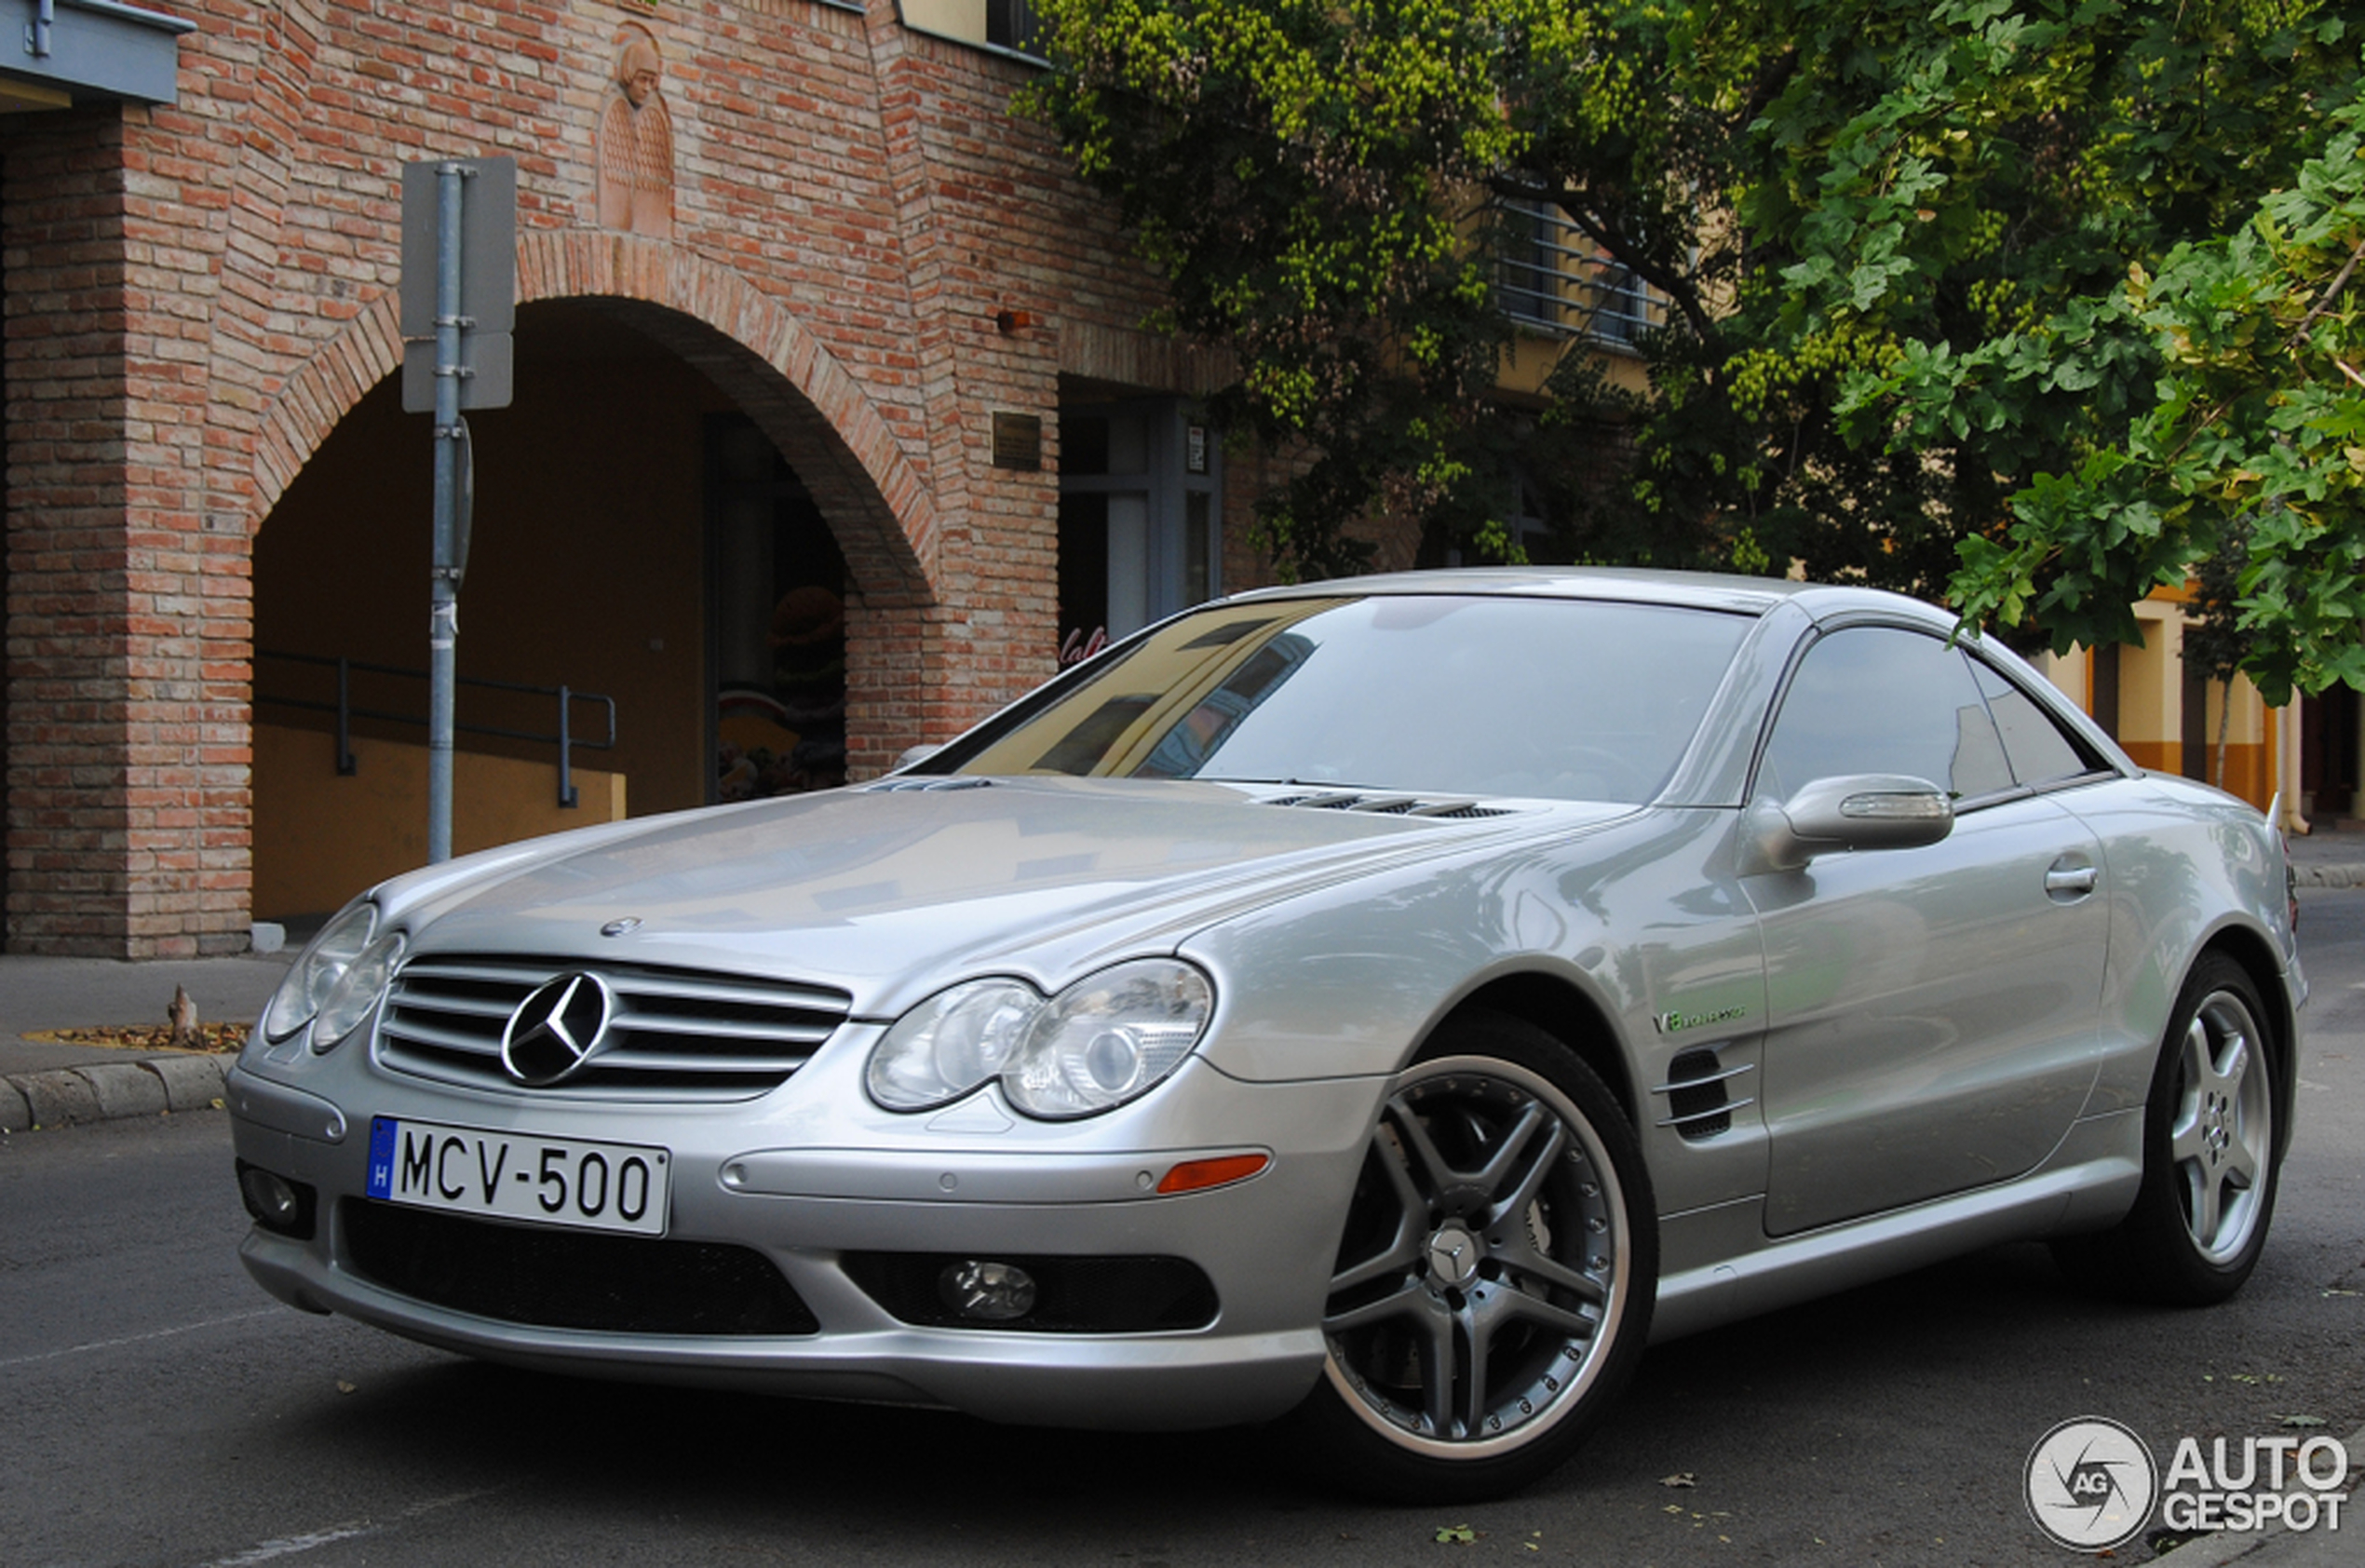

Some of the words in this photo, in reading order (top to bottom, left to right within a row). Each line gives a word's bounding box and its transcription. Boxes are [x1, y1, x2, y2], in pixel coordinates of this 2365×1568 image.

[1653, 1011, 1682, 1034] V8
[374, 1166, 388, 1187] H
[401, 1130, 650, 1222] MCV-500
